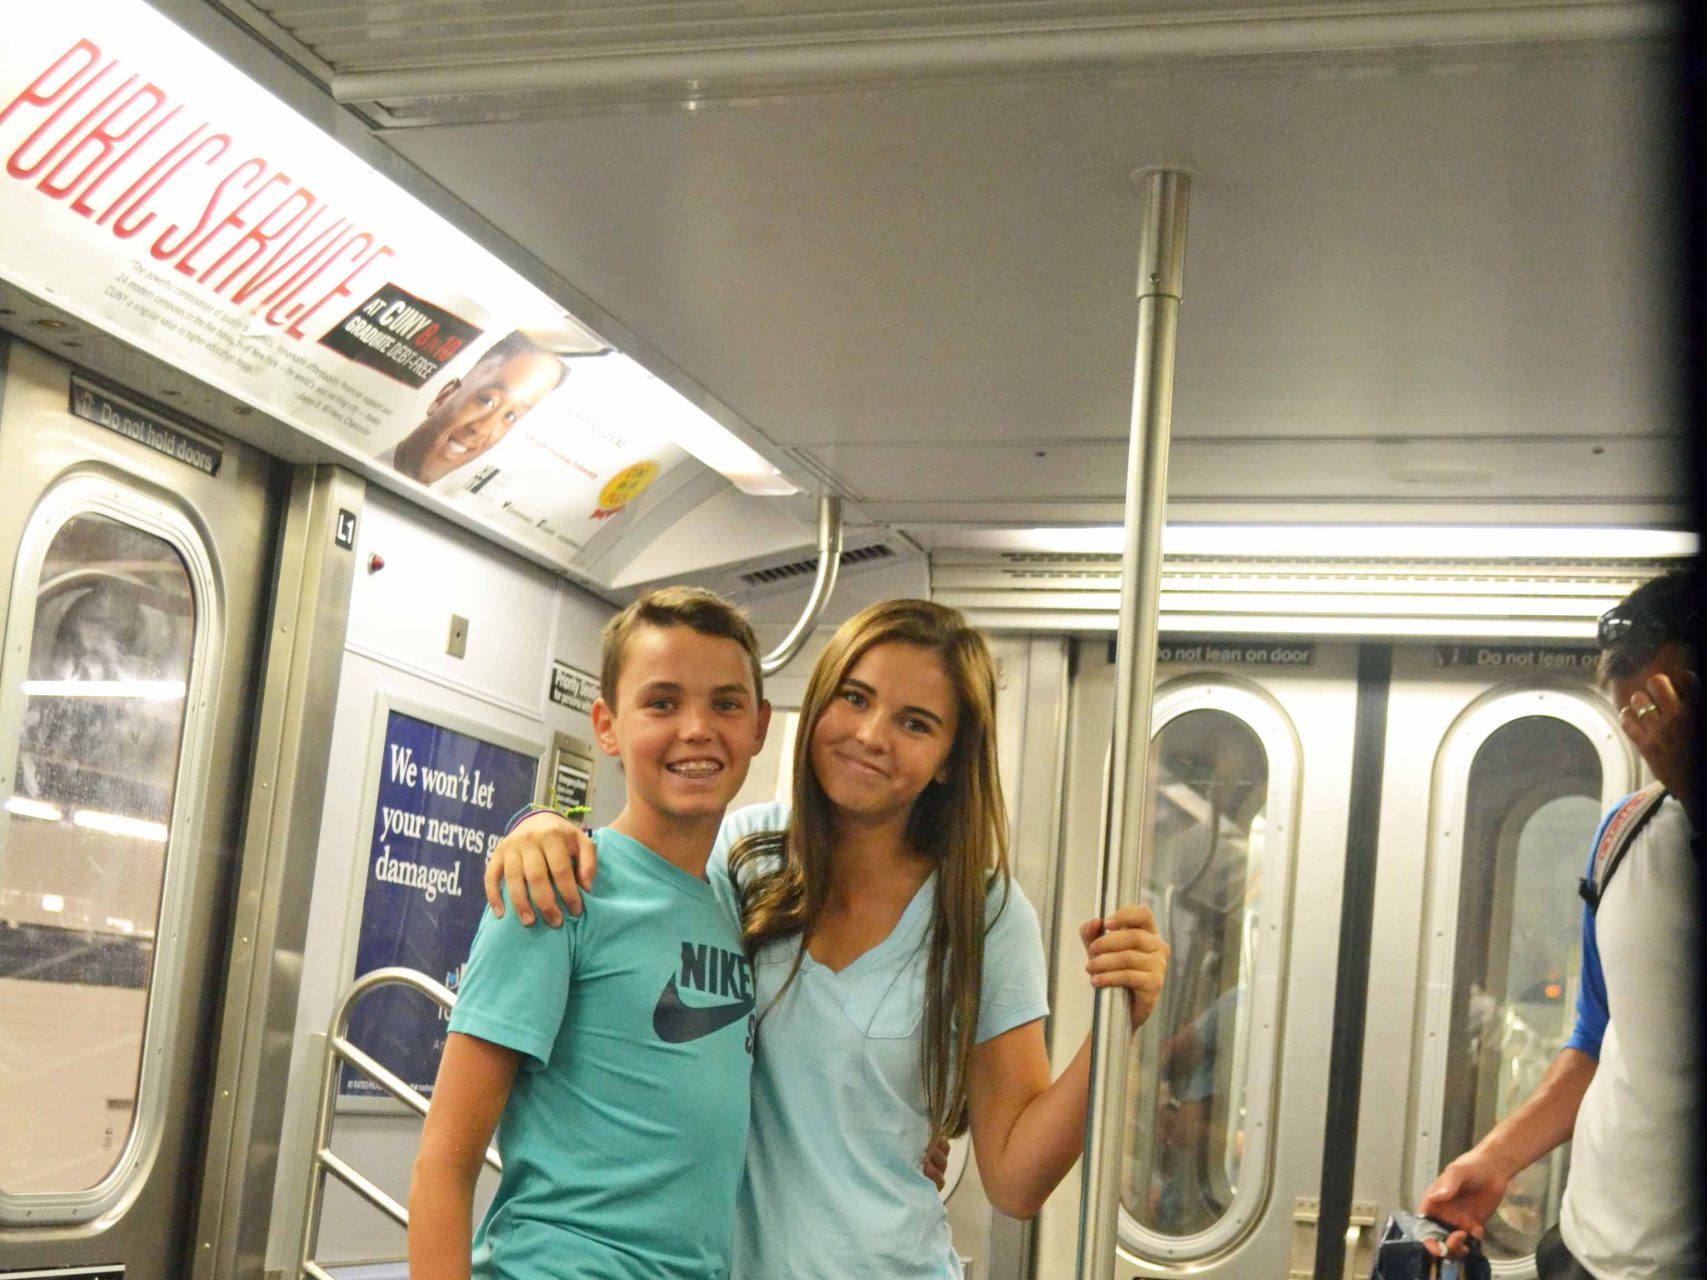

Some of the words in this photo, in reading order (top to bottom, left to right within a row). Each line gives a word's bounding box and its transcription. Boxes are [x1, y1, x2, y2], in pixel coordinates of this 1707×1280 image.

[0, 38, 232, 240] PUBLIC
[150, 158, 395, 342] SERVICE
[344, 316, 395, 354] GRADUATE
[387, 342, 438, 379] DEBT-FREE
[363, 298, 387, 317] AT
[379, 300, 432, 340] CUNY
[102, 403, 119, 430] Do
[122, 418, 145, 441] not
[147, 424, 176, 455] hold
[178, 440, 212, 471] doors
[337, 514, 354, 544] L1
[1175, 647, 1200, 661] not
[1205, 646, 1241, 663] lean
[1245, 649, 1269, 663] on
[1270, 646, 1309, 663] door
[1477, 650, 1502, 665] Do
[1505, 651, 1533, 666] not
[1539, 650, 1576, 666] lean
[391, 743, 417, 788] We
[421, 765, 470, 803] won't
[471, 770, 495, 810] let
[380, 806, 425, 842] your
[426, 818, 484, 854] nerves
[375, 844, 462, 902] damaged.
[680, 941, 753, 1003] NIKE
